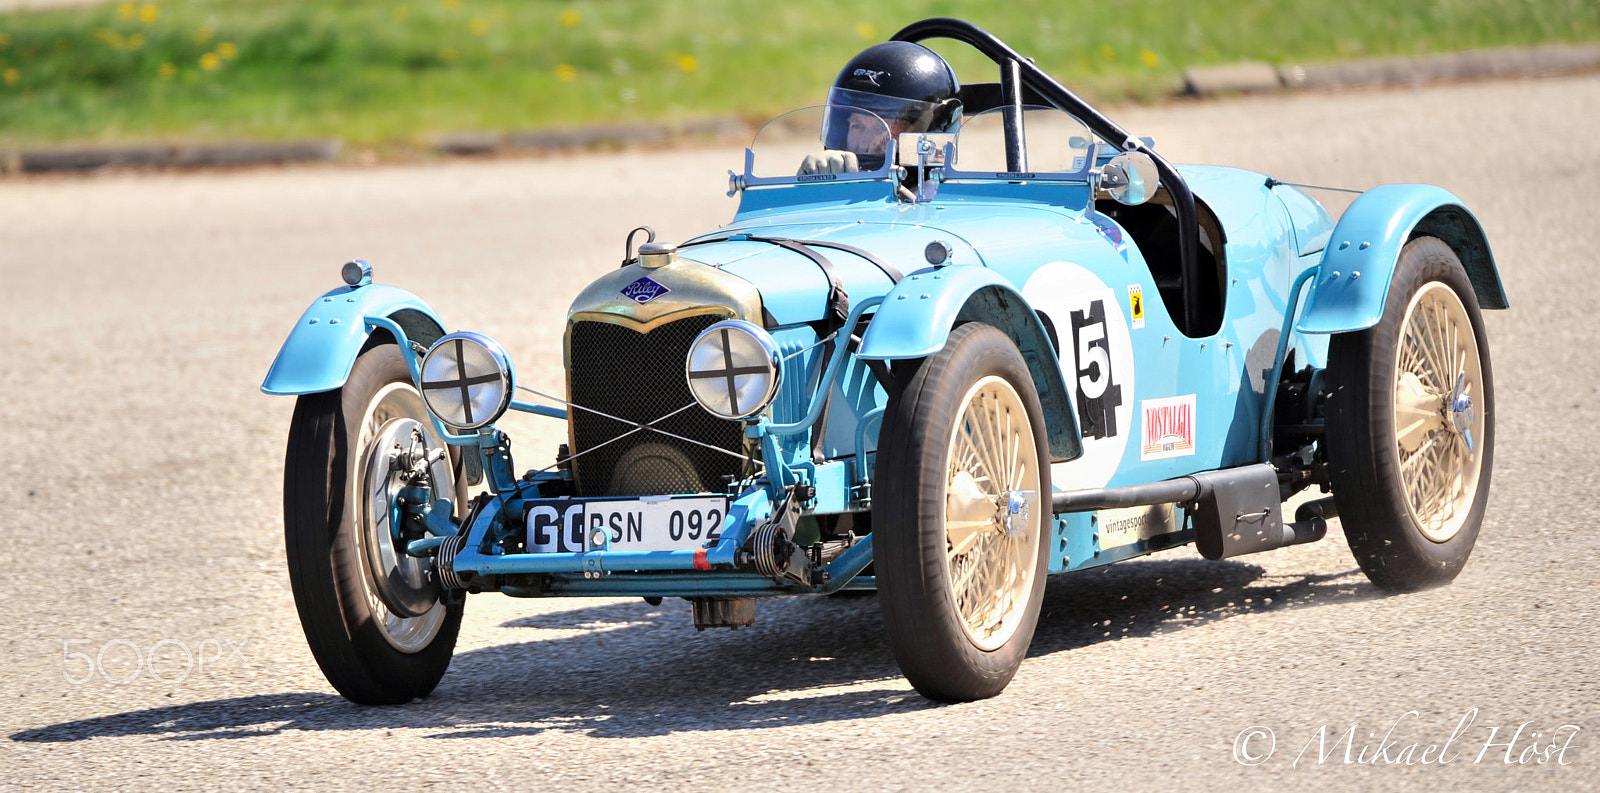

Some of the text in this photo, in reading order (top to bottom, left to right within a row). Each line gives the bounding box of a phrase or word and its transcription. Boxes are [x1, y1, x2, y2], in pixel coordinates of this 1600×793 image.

[625, 281, 660, 303] Riley
[1079, 321, 1110, 399] 5
[1145, 403, 1192, 446] NOSTALGIA
[669, 508, 722, 542] 092
